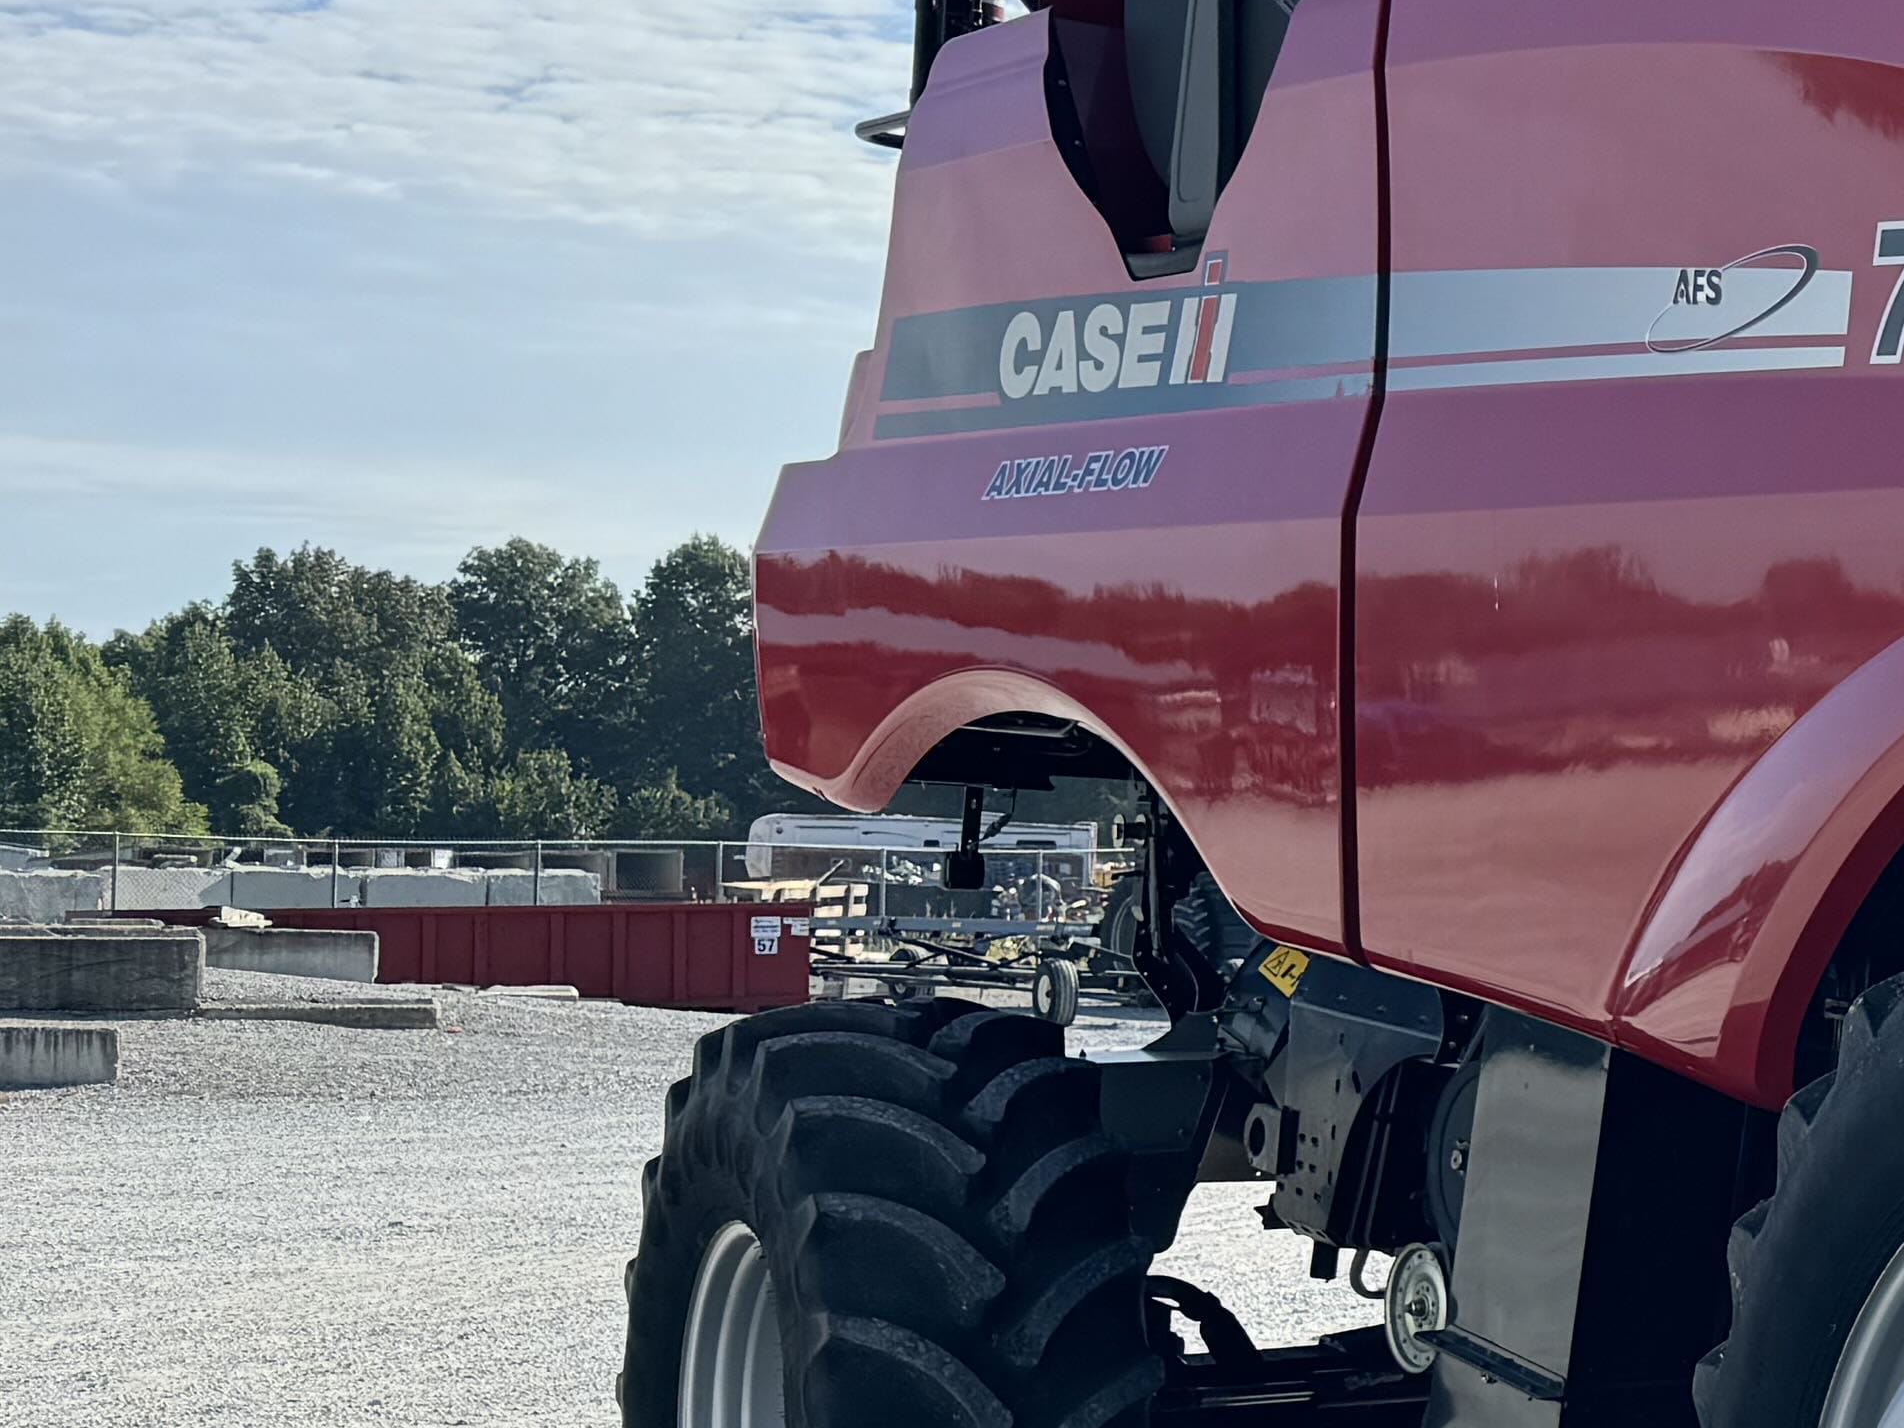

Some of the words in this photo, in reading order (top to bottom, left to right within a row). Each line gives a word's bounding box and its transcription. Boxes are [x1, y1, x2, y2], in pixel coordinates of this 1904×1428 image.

[1672, 269, 1722, 306] AFS
[981, 445, 1168, 499] AXIAL-FLOW
[757, 939, 775, 952] 57
